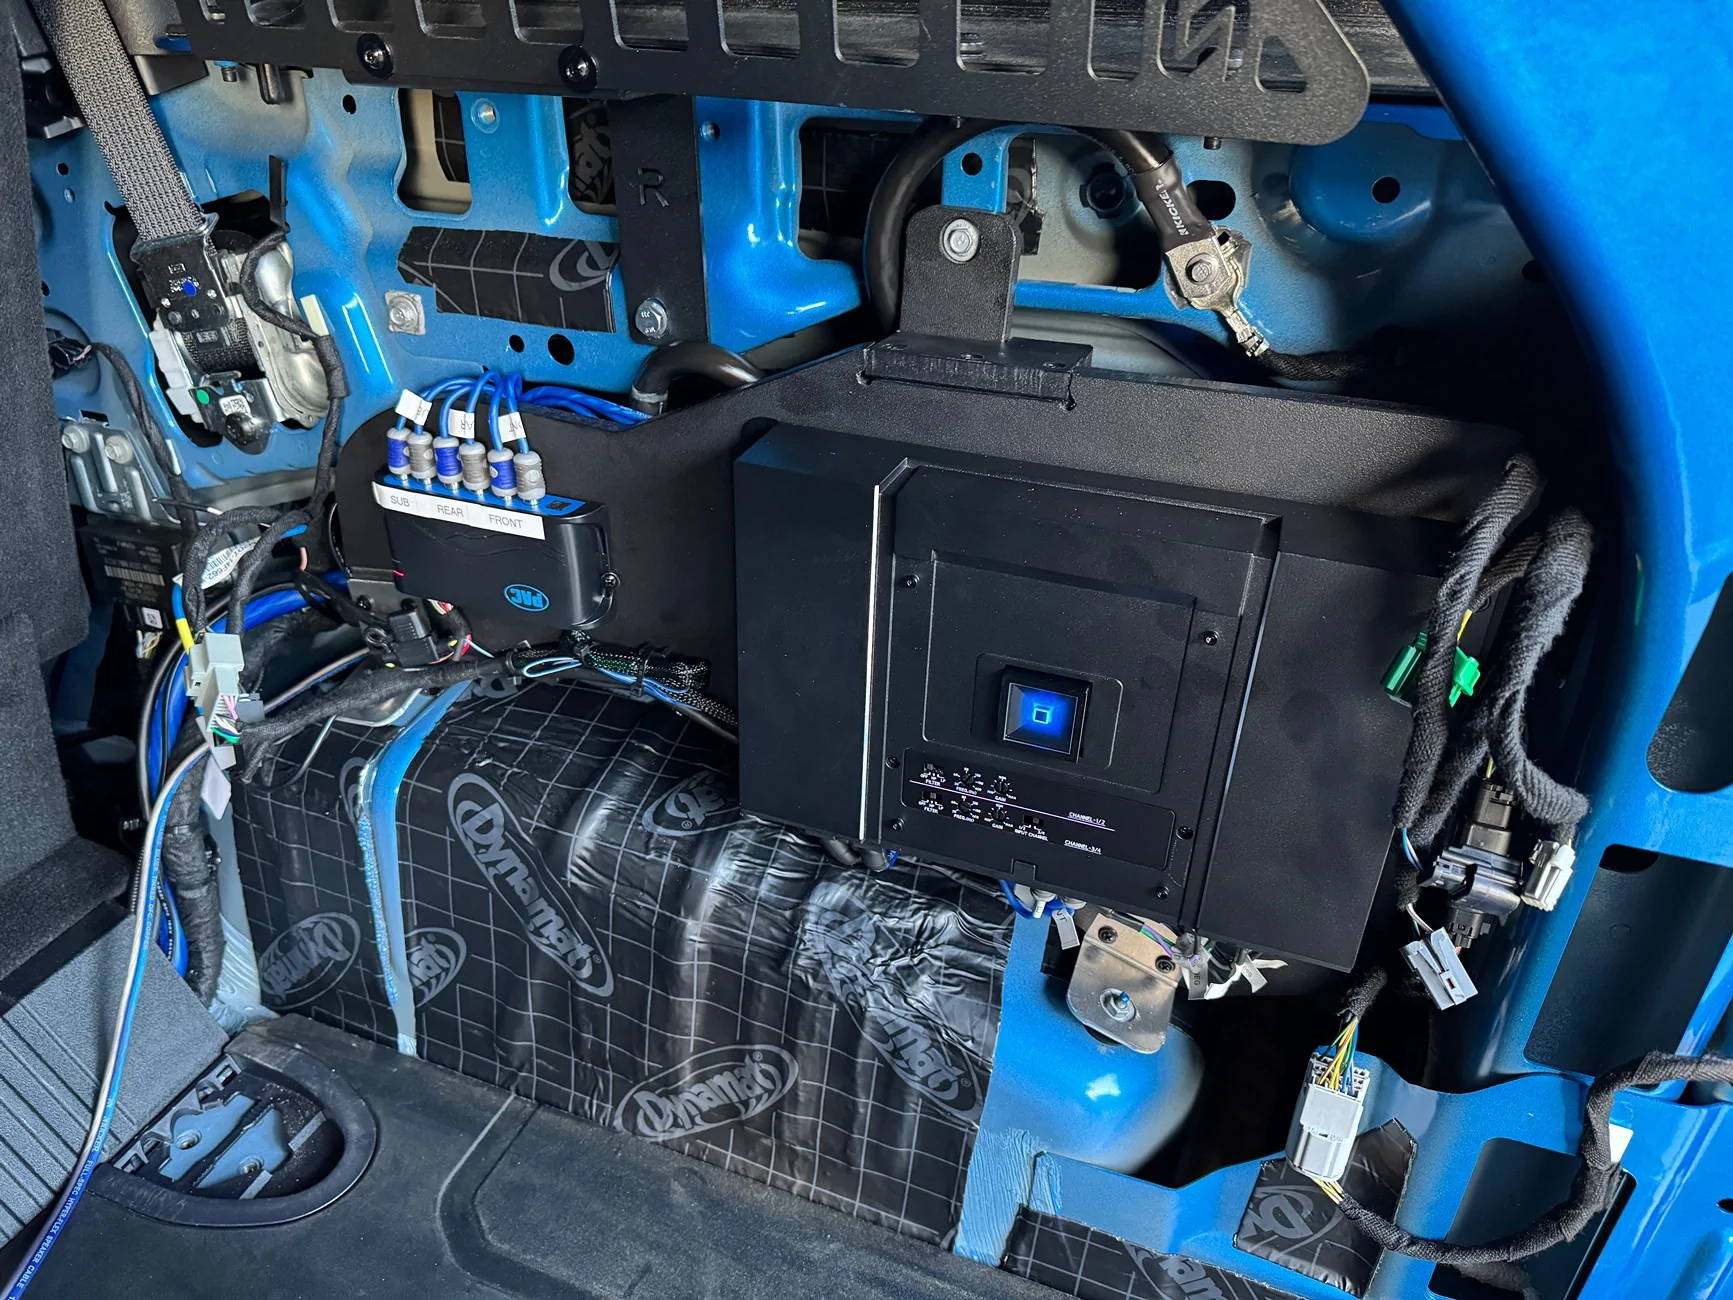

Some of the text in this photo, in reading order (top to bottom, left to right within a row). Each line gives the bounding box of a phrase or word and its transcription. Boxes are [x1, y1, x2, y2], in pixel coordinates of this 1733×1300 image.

[638, 167, 669, 207] R
[390, 495, 523, 529] SUB REAR FRONT
[510, 588, 545, 608] PAC
[925, 779, 941, 787] FILTER
[923, 806, 939, 814] FILTER
[1014, 828, 1049, 842] INPUT CHANNEL
[461, 801, 596, 968] Dynamat
[633, 1053, 776, 1131] Dynamat
[71, 1159, 94, 1197] FULL-SPEC
[53, 1197, 76, 1234] HYPER-FLEX
[32, 1234, 54, 1263] SPEAKER
[16, 1265, 35, 1288] CABLE
